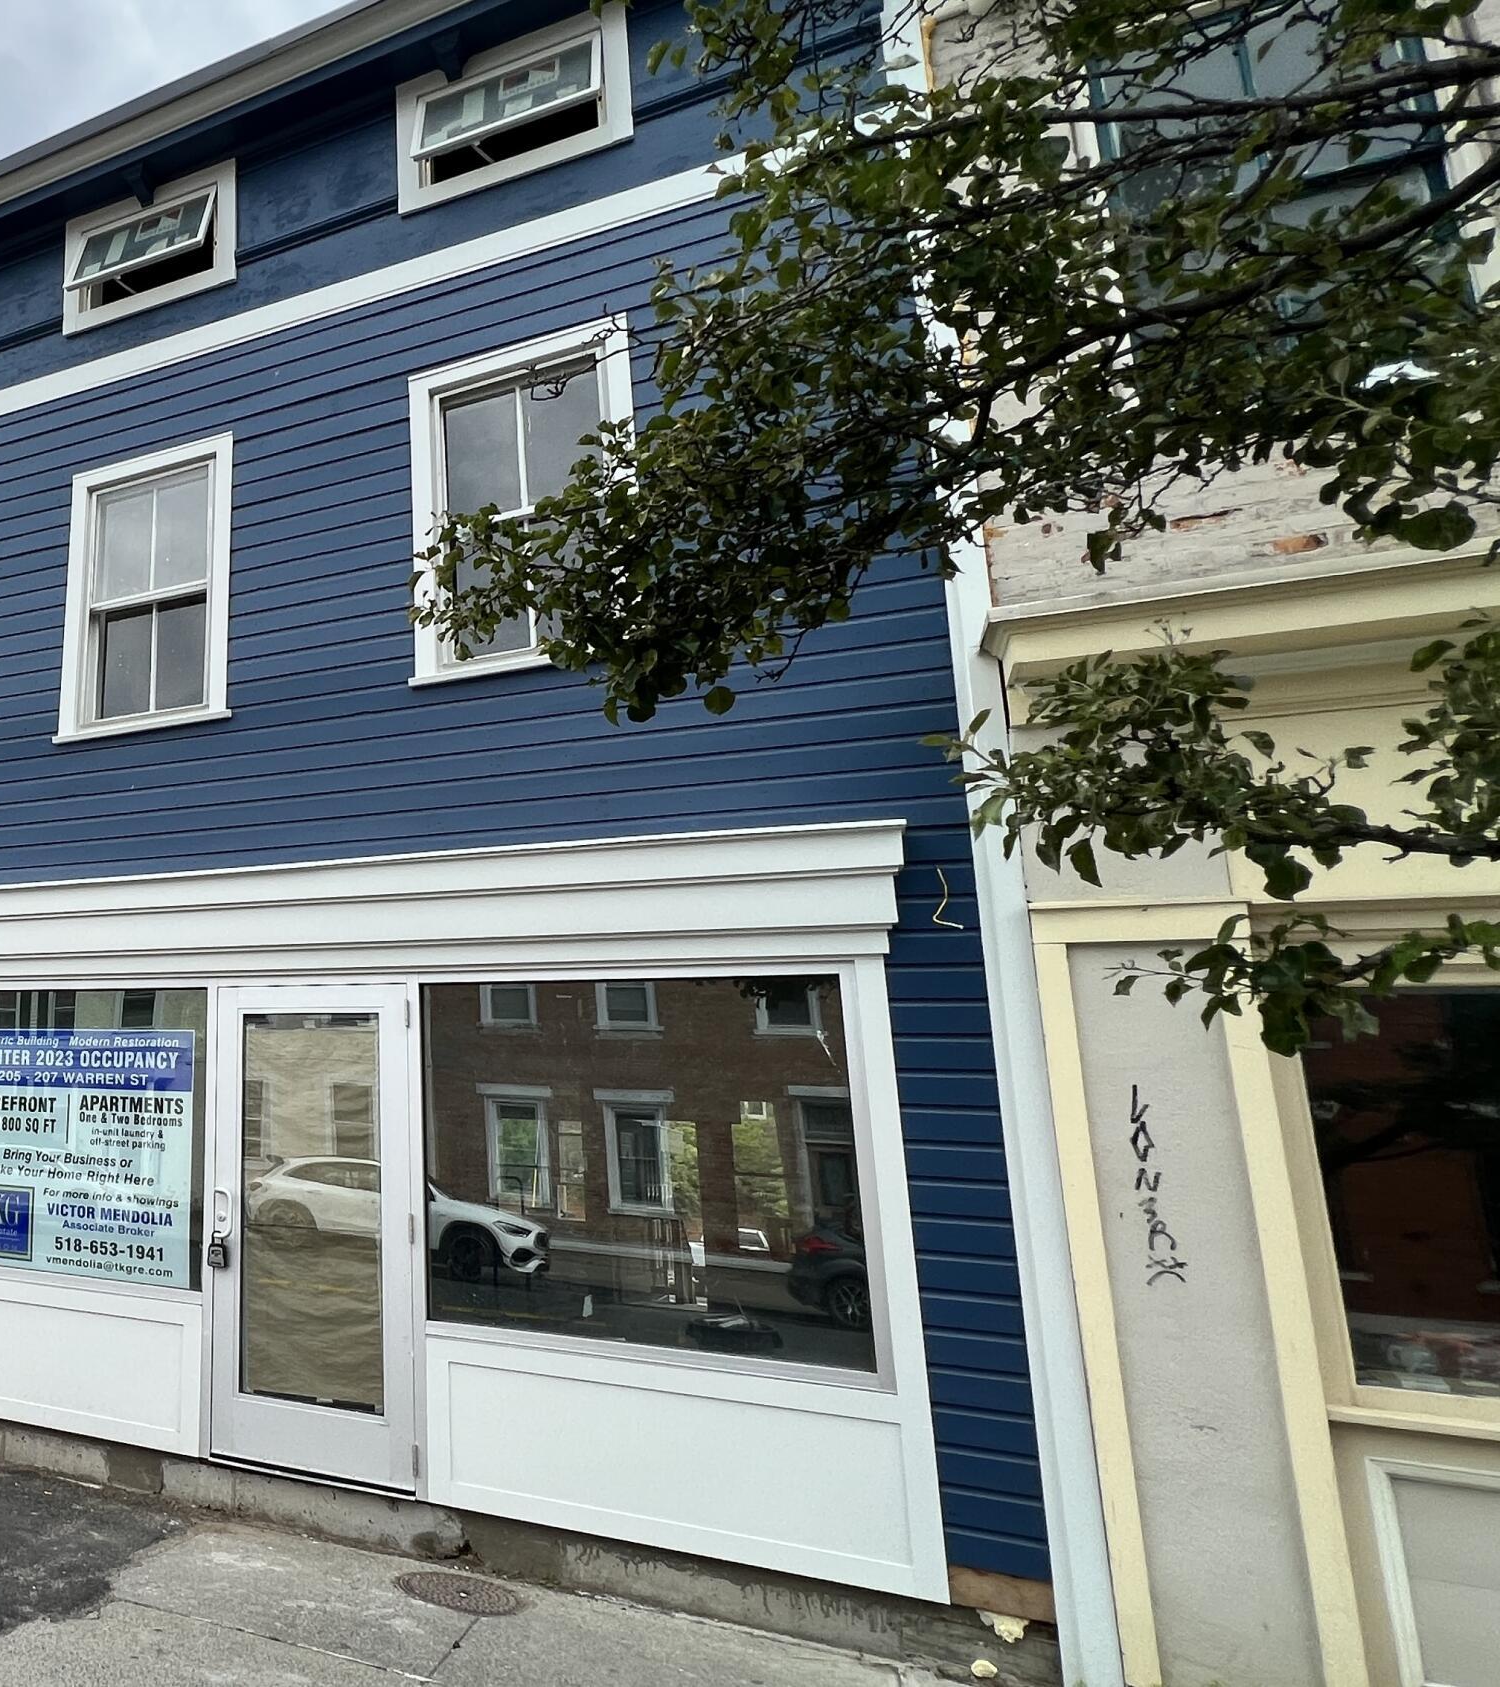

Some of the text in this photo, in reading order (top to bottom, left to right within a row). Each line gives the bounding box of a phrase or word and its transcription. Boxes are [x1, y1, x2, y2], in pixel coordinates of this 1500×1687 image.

[17, 1036, 60, 1048] Building
[69, 1036, 110, 1046] Modern
[114, 1036, 180, 1048] Restoration
[36, 1050, 74, 1066] 2023
[80, 1050, 179, 1069] OCCUPANCY
[34, 1072, 58, 1083] 207
[62, 1072, 125, 1084] WARREN
[130, 1074, 148, 1086] ST
[80, 1095, 184, 1114] APARTMENTS
[25, 1118, 39, 1134] SQ
[44, 1118, 56, 1133] FT
[80, 1112, 183, 1127] One & Two Bedrooms
[92, 1127, 164, 1140] in-unit laundry &
[90, 1138, 166, 1152] off-street parking
[3, 1148, 133, 1168] Bring Your Business or
[18, 1165, 44, 1177] Your
[47, 1167, 82, 1180] Home
[87, 1171, 120, 1186] Right
[124, 1173, 155, 1187] Here
[43, 1188, 179, 1209] For more info & showings
[47, 1203, 173, 1227] VICTOR MENDOLIA
[62, 1220, 155, 1237] Associate Broker
[55, 1236, 164, 1262] 518-653-1941
[46, 1256, 173, 1278] vmendolia@tkgre.com
